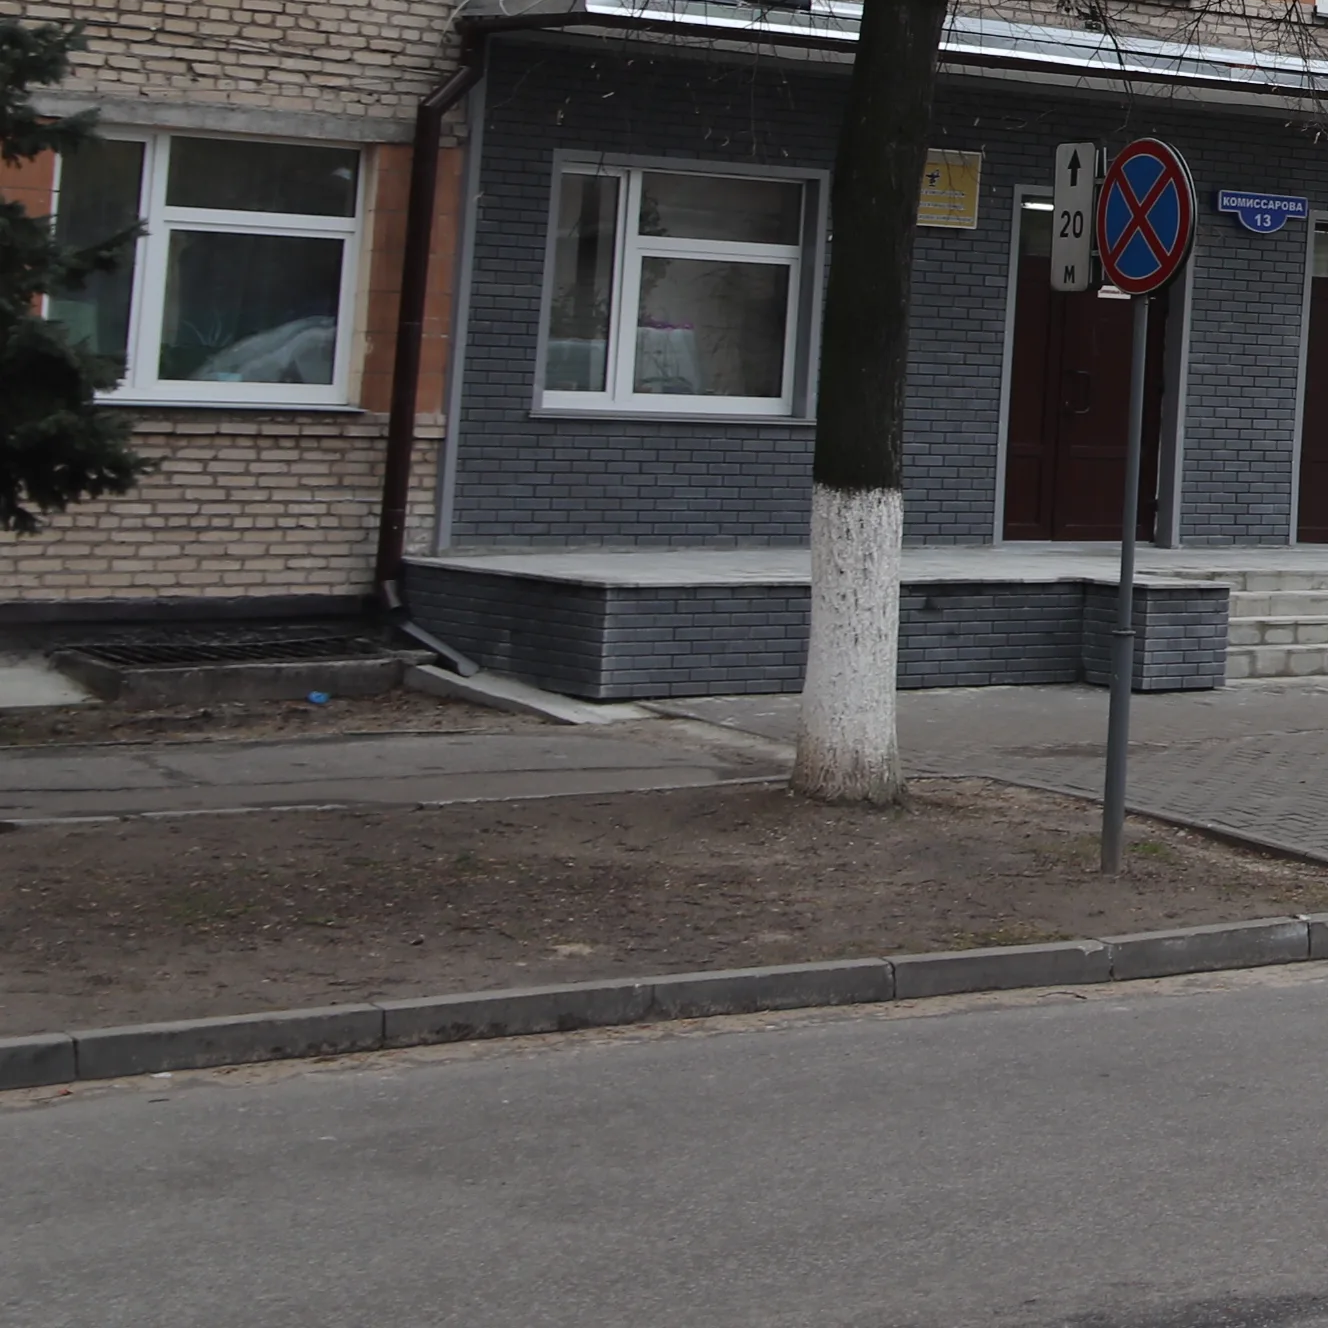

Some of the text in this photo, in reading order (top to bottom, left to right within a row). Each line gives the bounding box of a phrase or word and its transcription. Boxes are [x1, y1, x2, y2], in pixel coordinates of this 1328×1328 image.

[1223, 197, 1303, 211] КОМИССАРОВА
[1060, 210, 1083, 238] 20
[1254, 214, 1271, 227] 13
[1063, 265, 1075, 283] М
